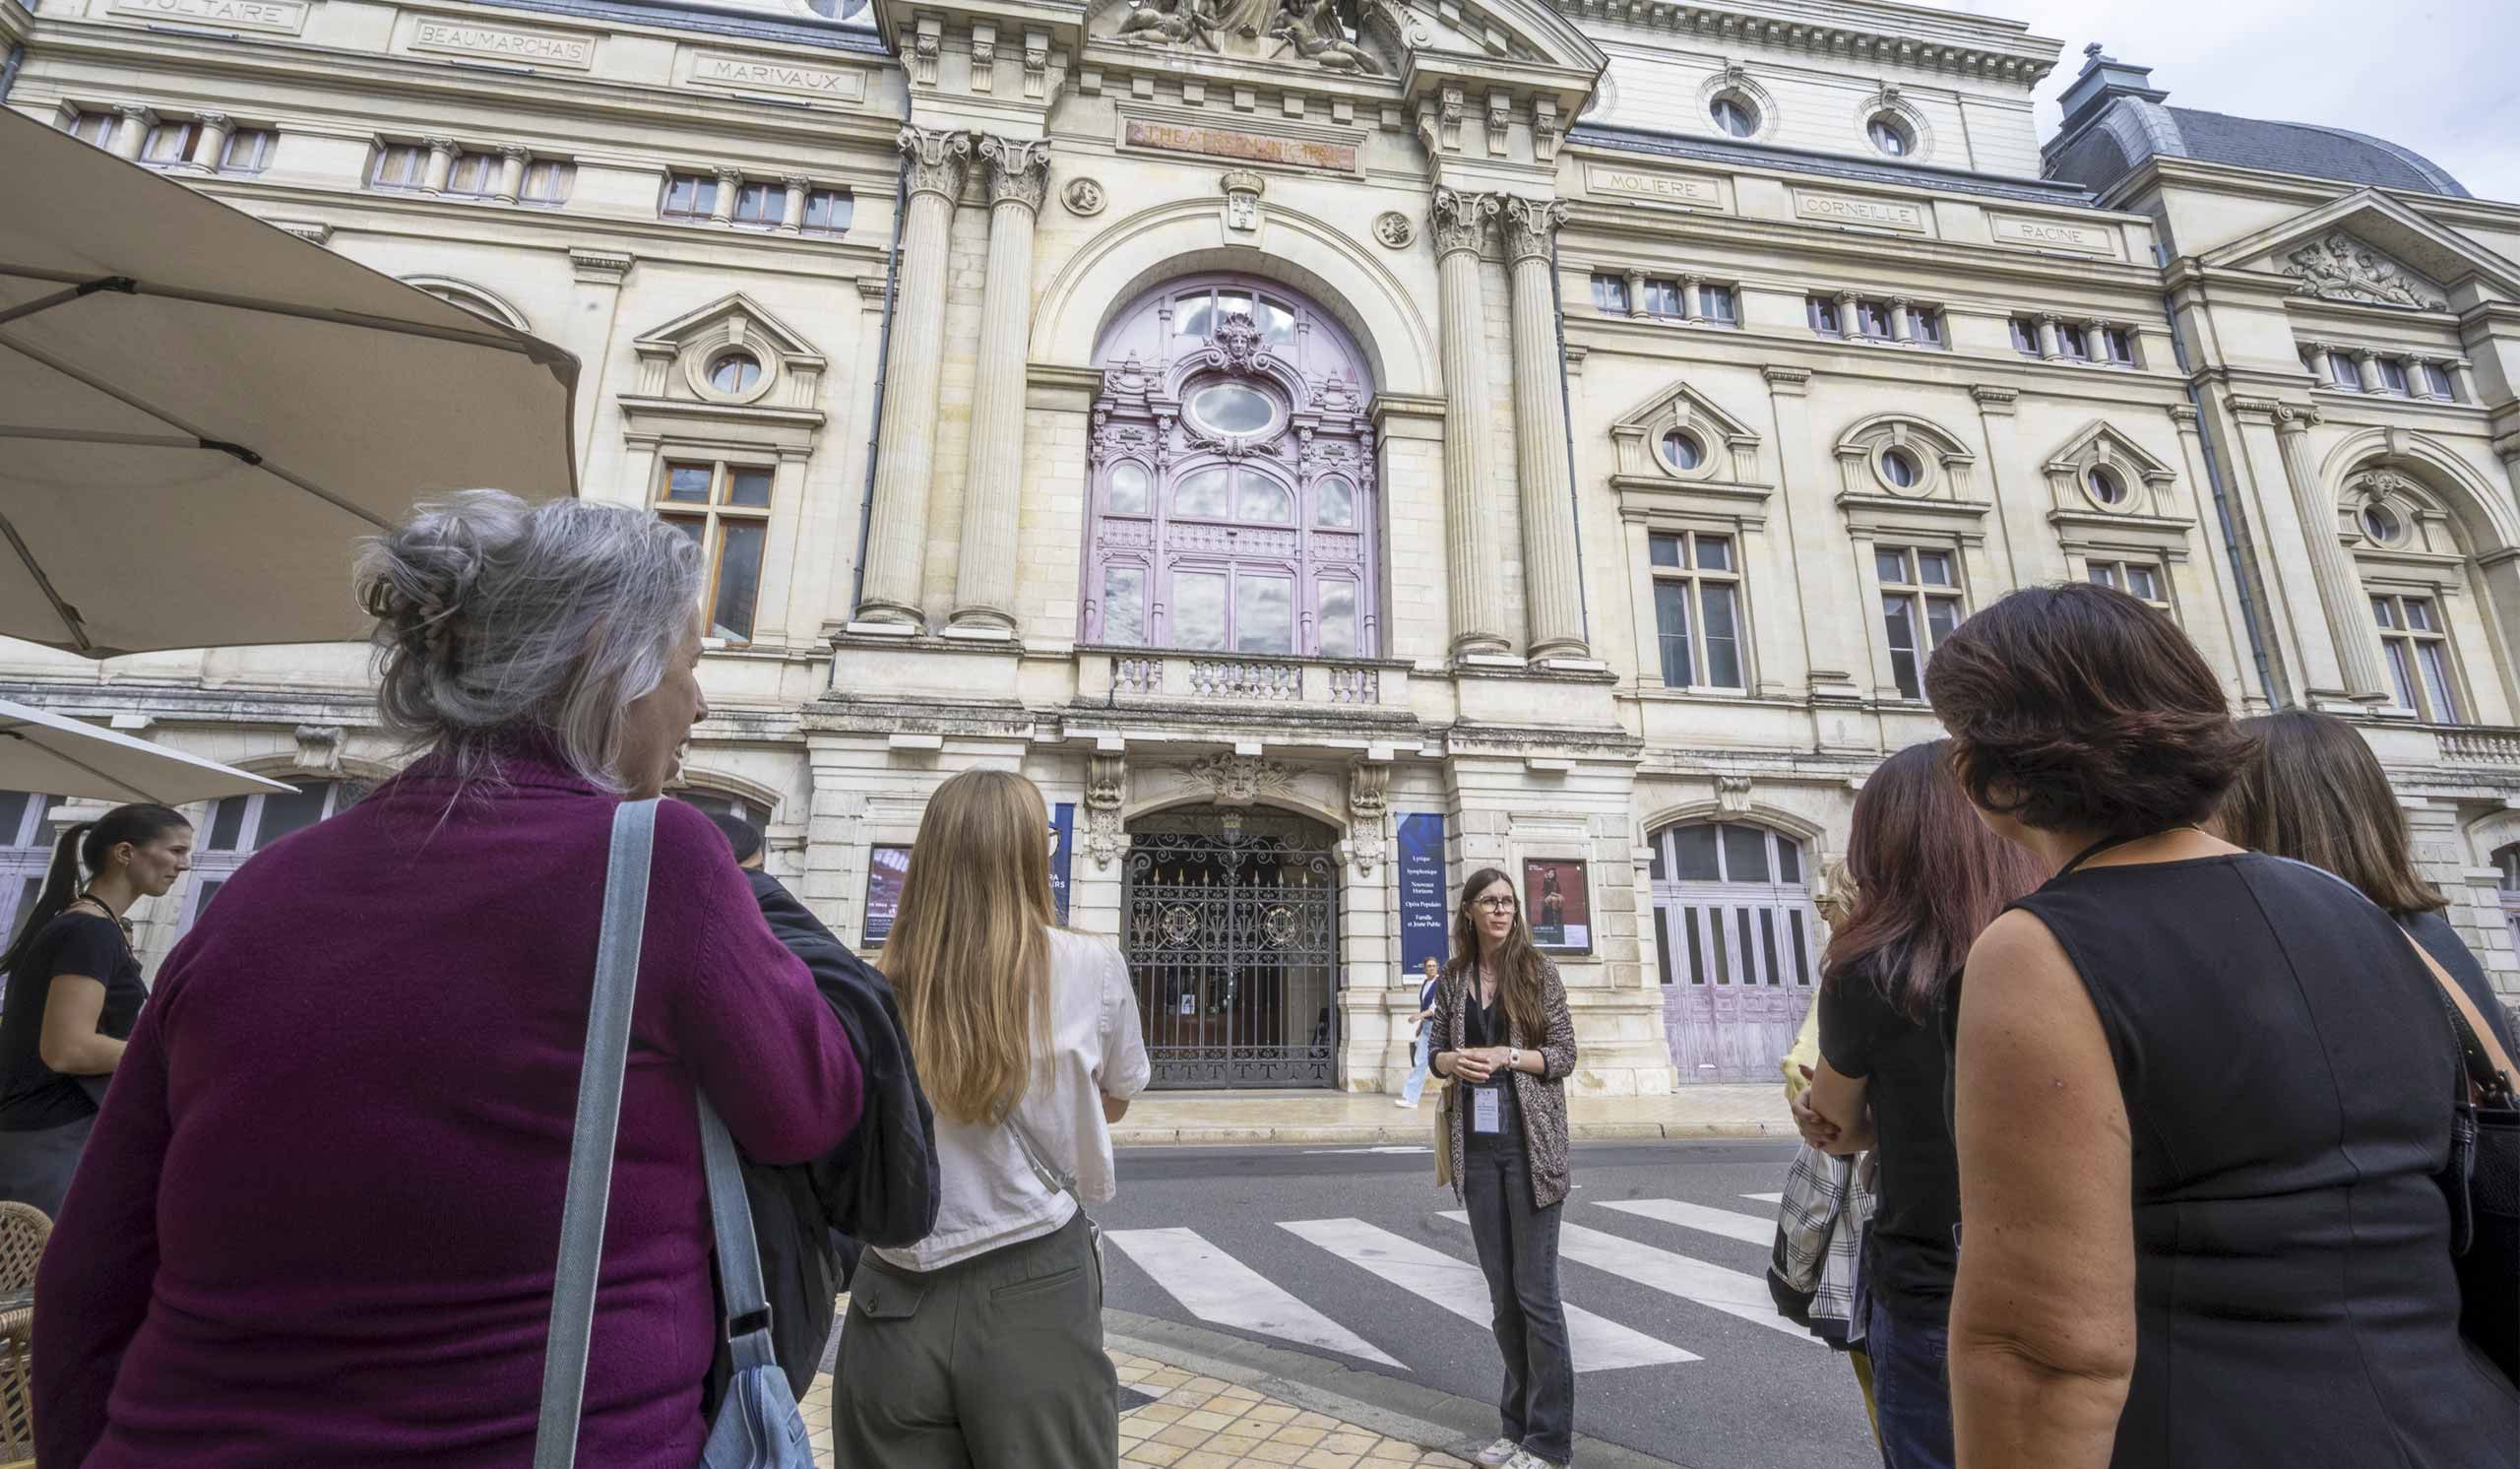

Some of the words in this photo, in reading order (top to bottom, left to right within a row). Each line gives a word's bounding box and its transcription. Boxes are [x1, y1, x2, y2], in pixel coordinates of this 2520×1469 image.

[421, 26, 585, 59] BEAUMARCHAIS
[715, 62, 841, 90] MARIVAUX
[1609, 174, 1698, 197] MOLIERE
[1806, 199, 1912, 223] CORNEILLE
[2021, 224, 2084, 243] RACINE
